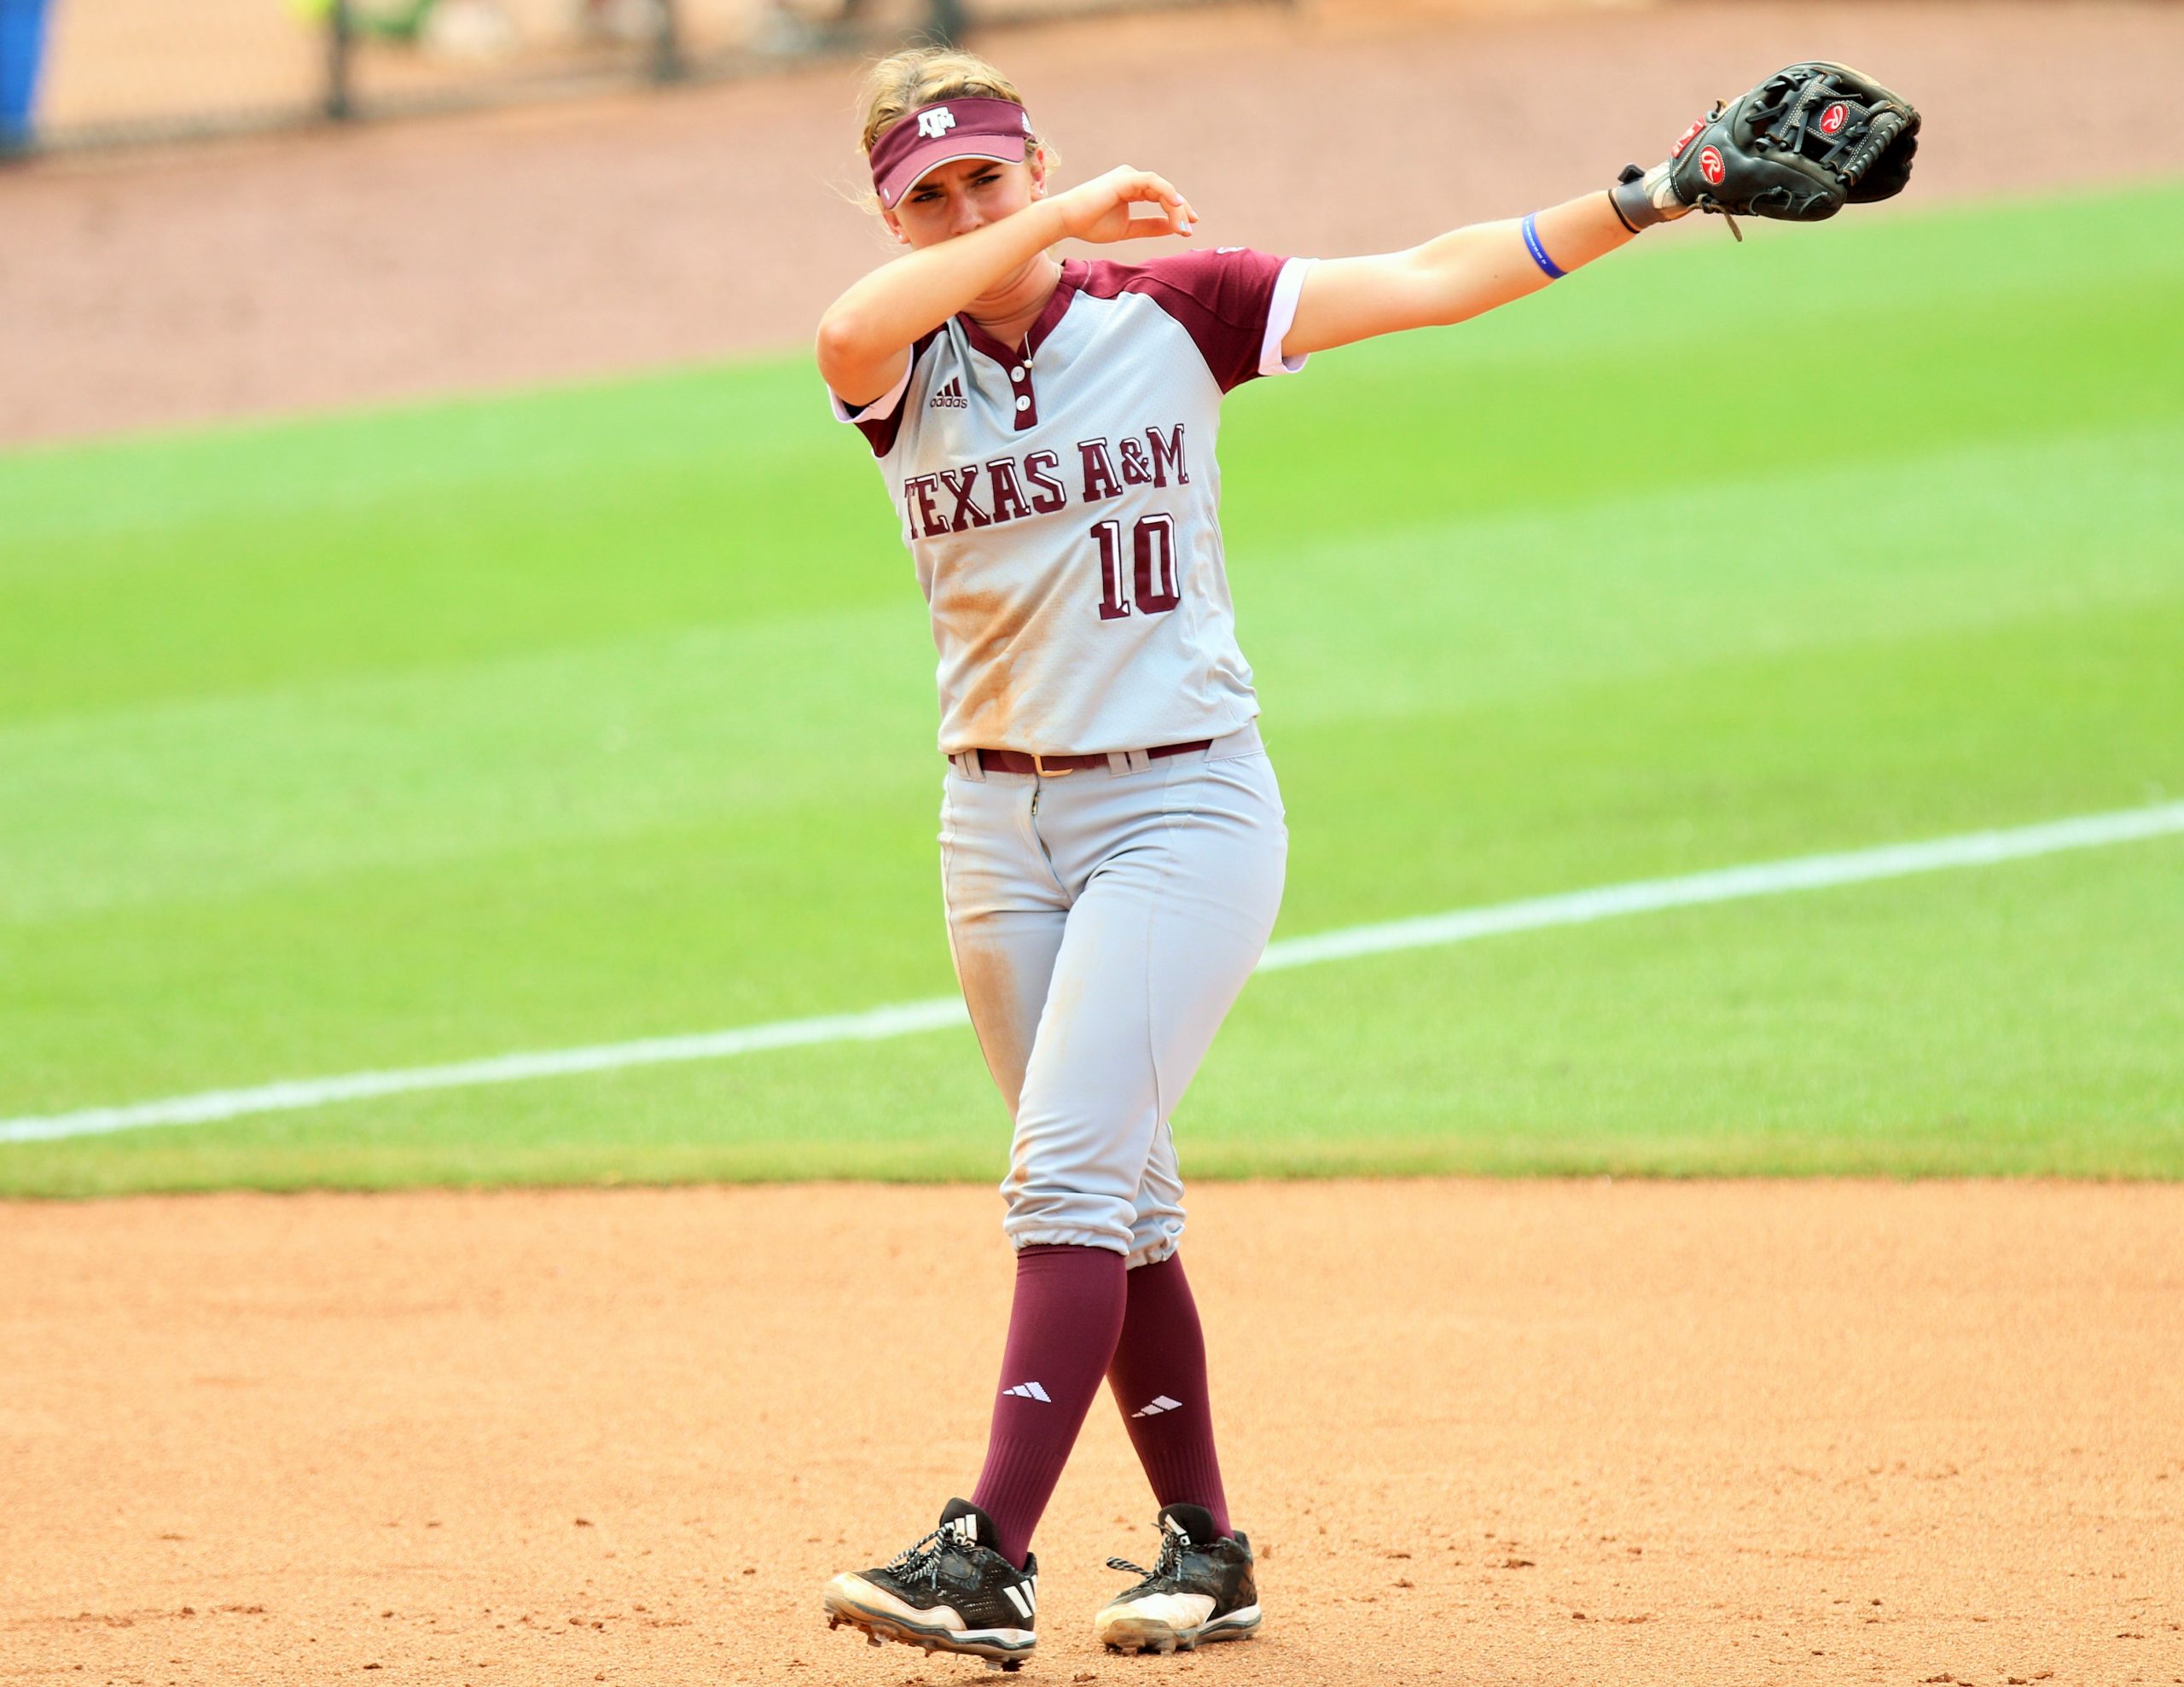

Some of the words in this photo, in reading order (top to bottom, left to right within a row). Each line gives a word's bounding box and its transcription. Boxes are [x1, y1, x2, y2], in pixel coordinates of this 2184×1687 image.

[929, 395, 968, 409] adidas
[904, 450, 1067, 539] TEXAS
[1077, 423, 1189, 503] A&M
[1090, 513, 1181, 620] 10
